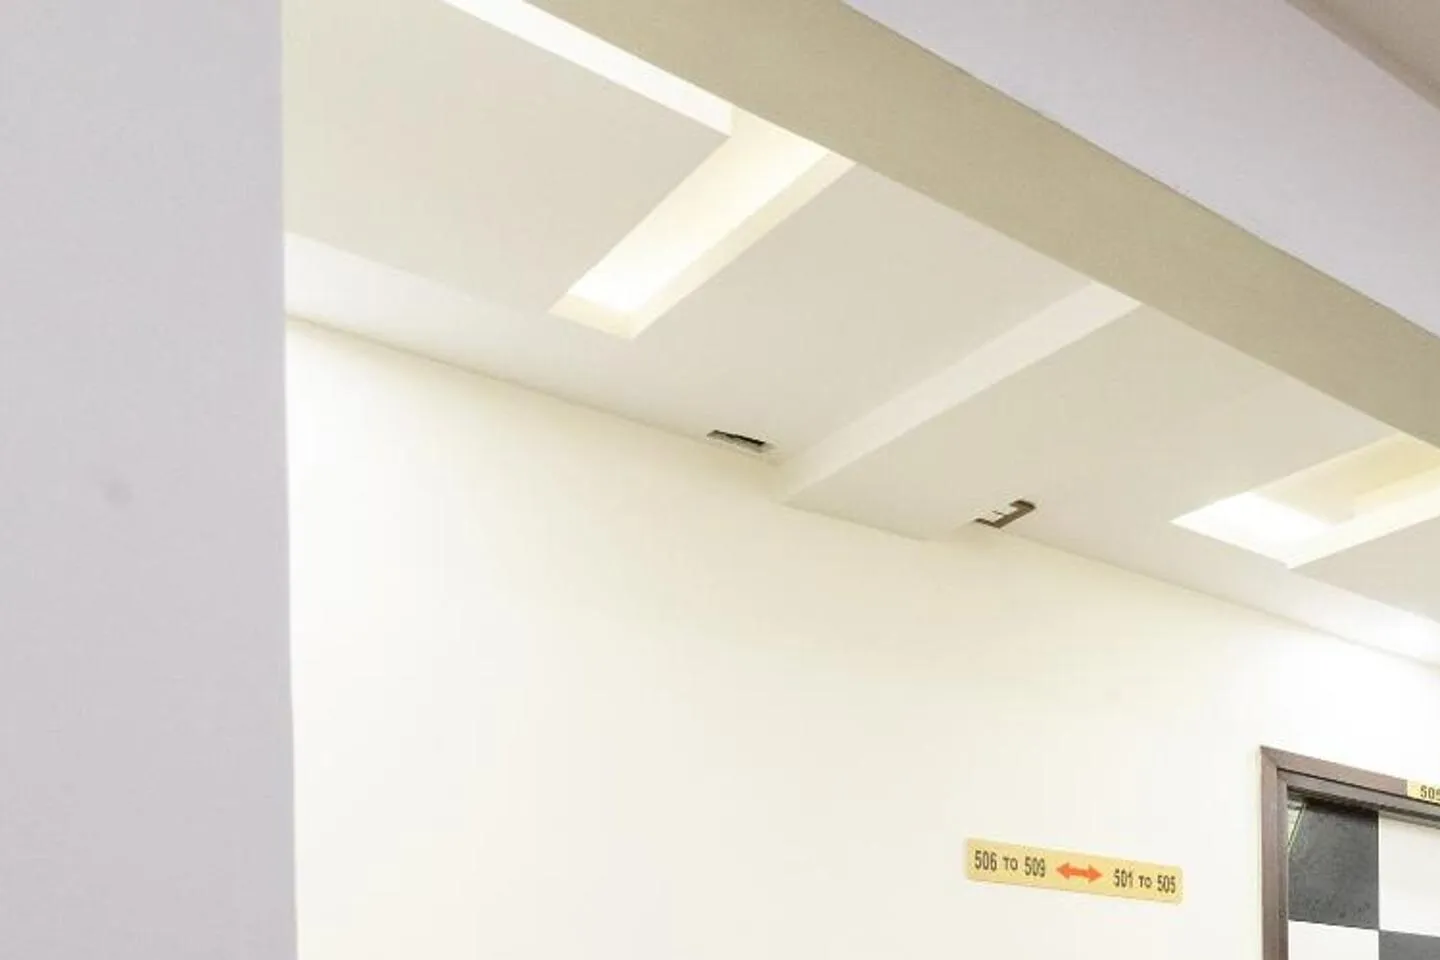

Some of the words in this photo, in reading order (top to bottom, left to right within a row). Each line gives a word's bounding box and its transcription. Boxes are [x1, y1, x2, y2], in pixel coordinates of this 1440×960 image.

[974, 849, 998, 872] 506
[1002, 856, 1019, 871] TO
[1024, 855, 1046, 878] 509
[1113, 868, 1133, 888] 501
[1138, 875, 1152, 889] TO
[1157, 874, 1176, 894] 505
